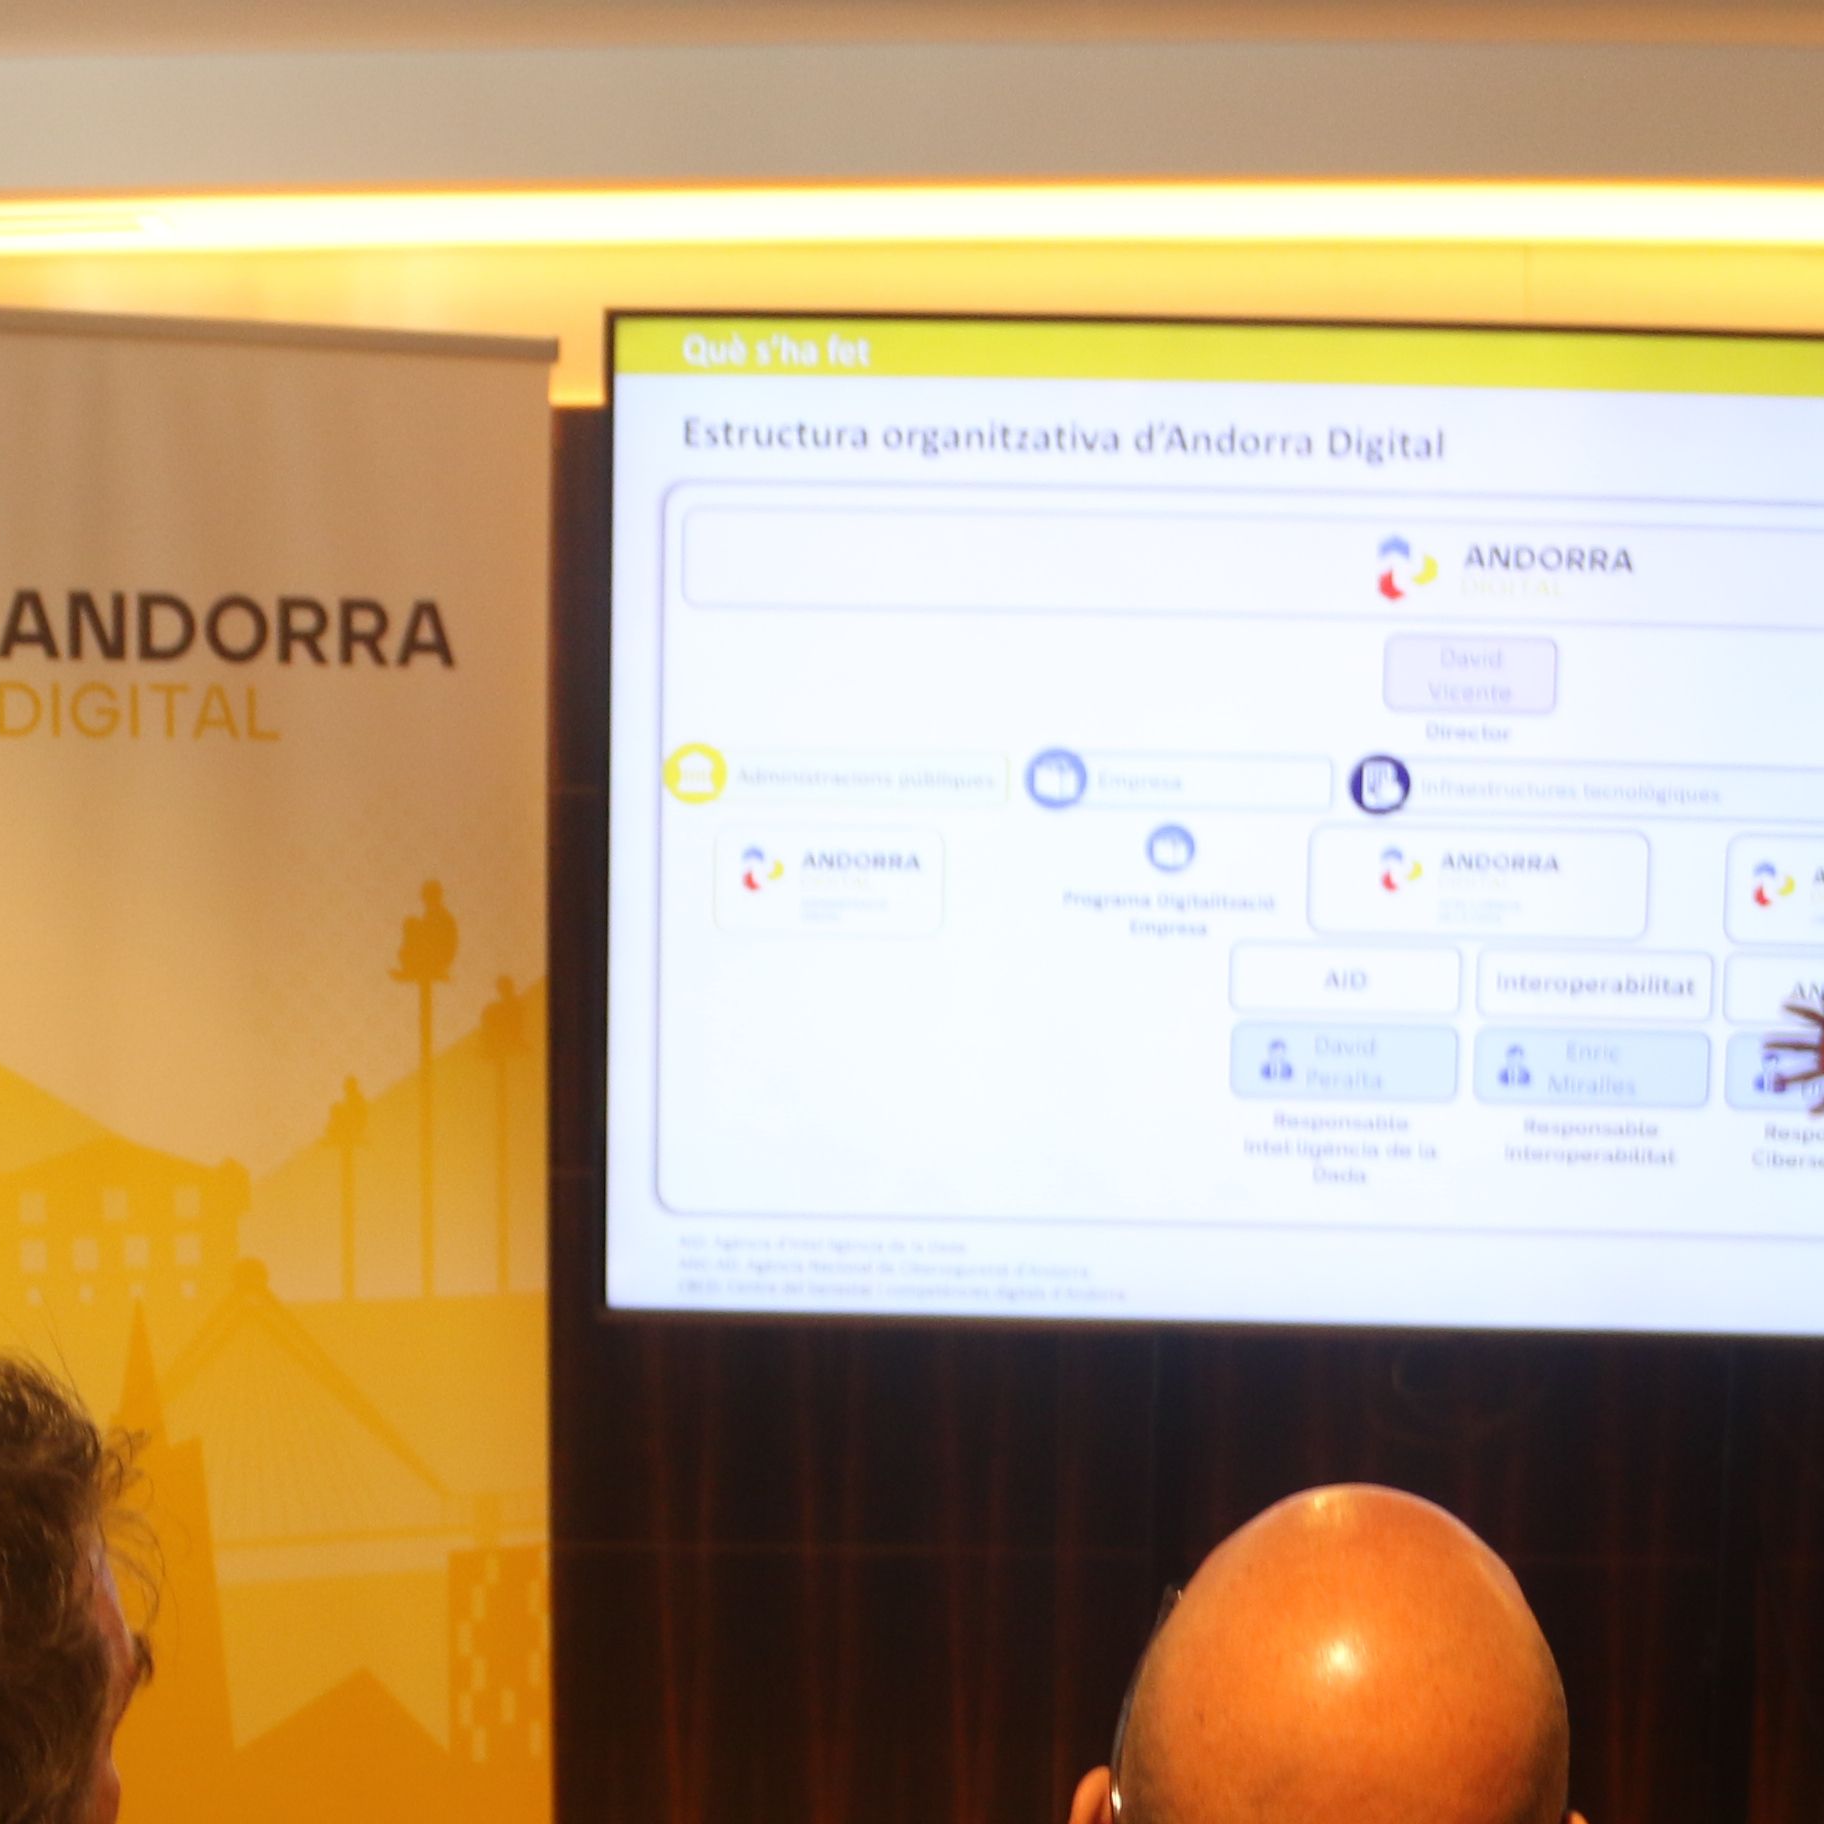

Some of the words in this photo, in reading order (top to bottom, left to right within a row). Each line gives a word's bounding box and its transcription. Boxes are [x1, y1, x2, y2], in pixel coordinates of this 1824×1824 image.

[682, 333, 747, 368] Què
[756, 334, 818, 366] s'ha
[828, 335, 870, 367] fet
[682, 417, 869, 450] Estructura
[882, 420, 1121, 457] organitzativa
[1133, 421, 1313, 457] d'Andorra
[1327, 425, 1445, 466] Digital
[1463, 543, 1635, 574] ANDORRA
[1439, 647, 1504, 671] David
[1426, 680, 1513, 703] Vicente
[1425, 721, 1512, 744] Director
[801, 849, 921, 871] ANDORRA
[1440, 851, 1560, 873] ANDORRA
[1322, 969, 1369, 992] AID
[1495, 970, 1696, 999] Interoperabilitat
[1313, 1036, 1377, 1058] David
[1565, 1040, 1620, 1063] Enric
[1272, 1111, 1410, 1137] Responsable
[1522, 1116, 1660, 1141] Responsable
